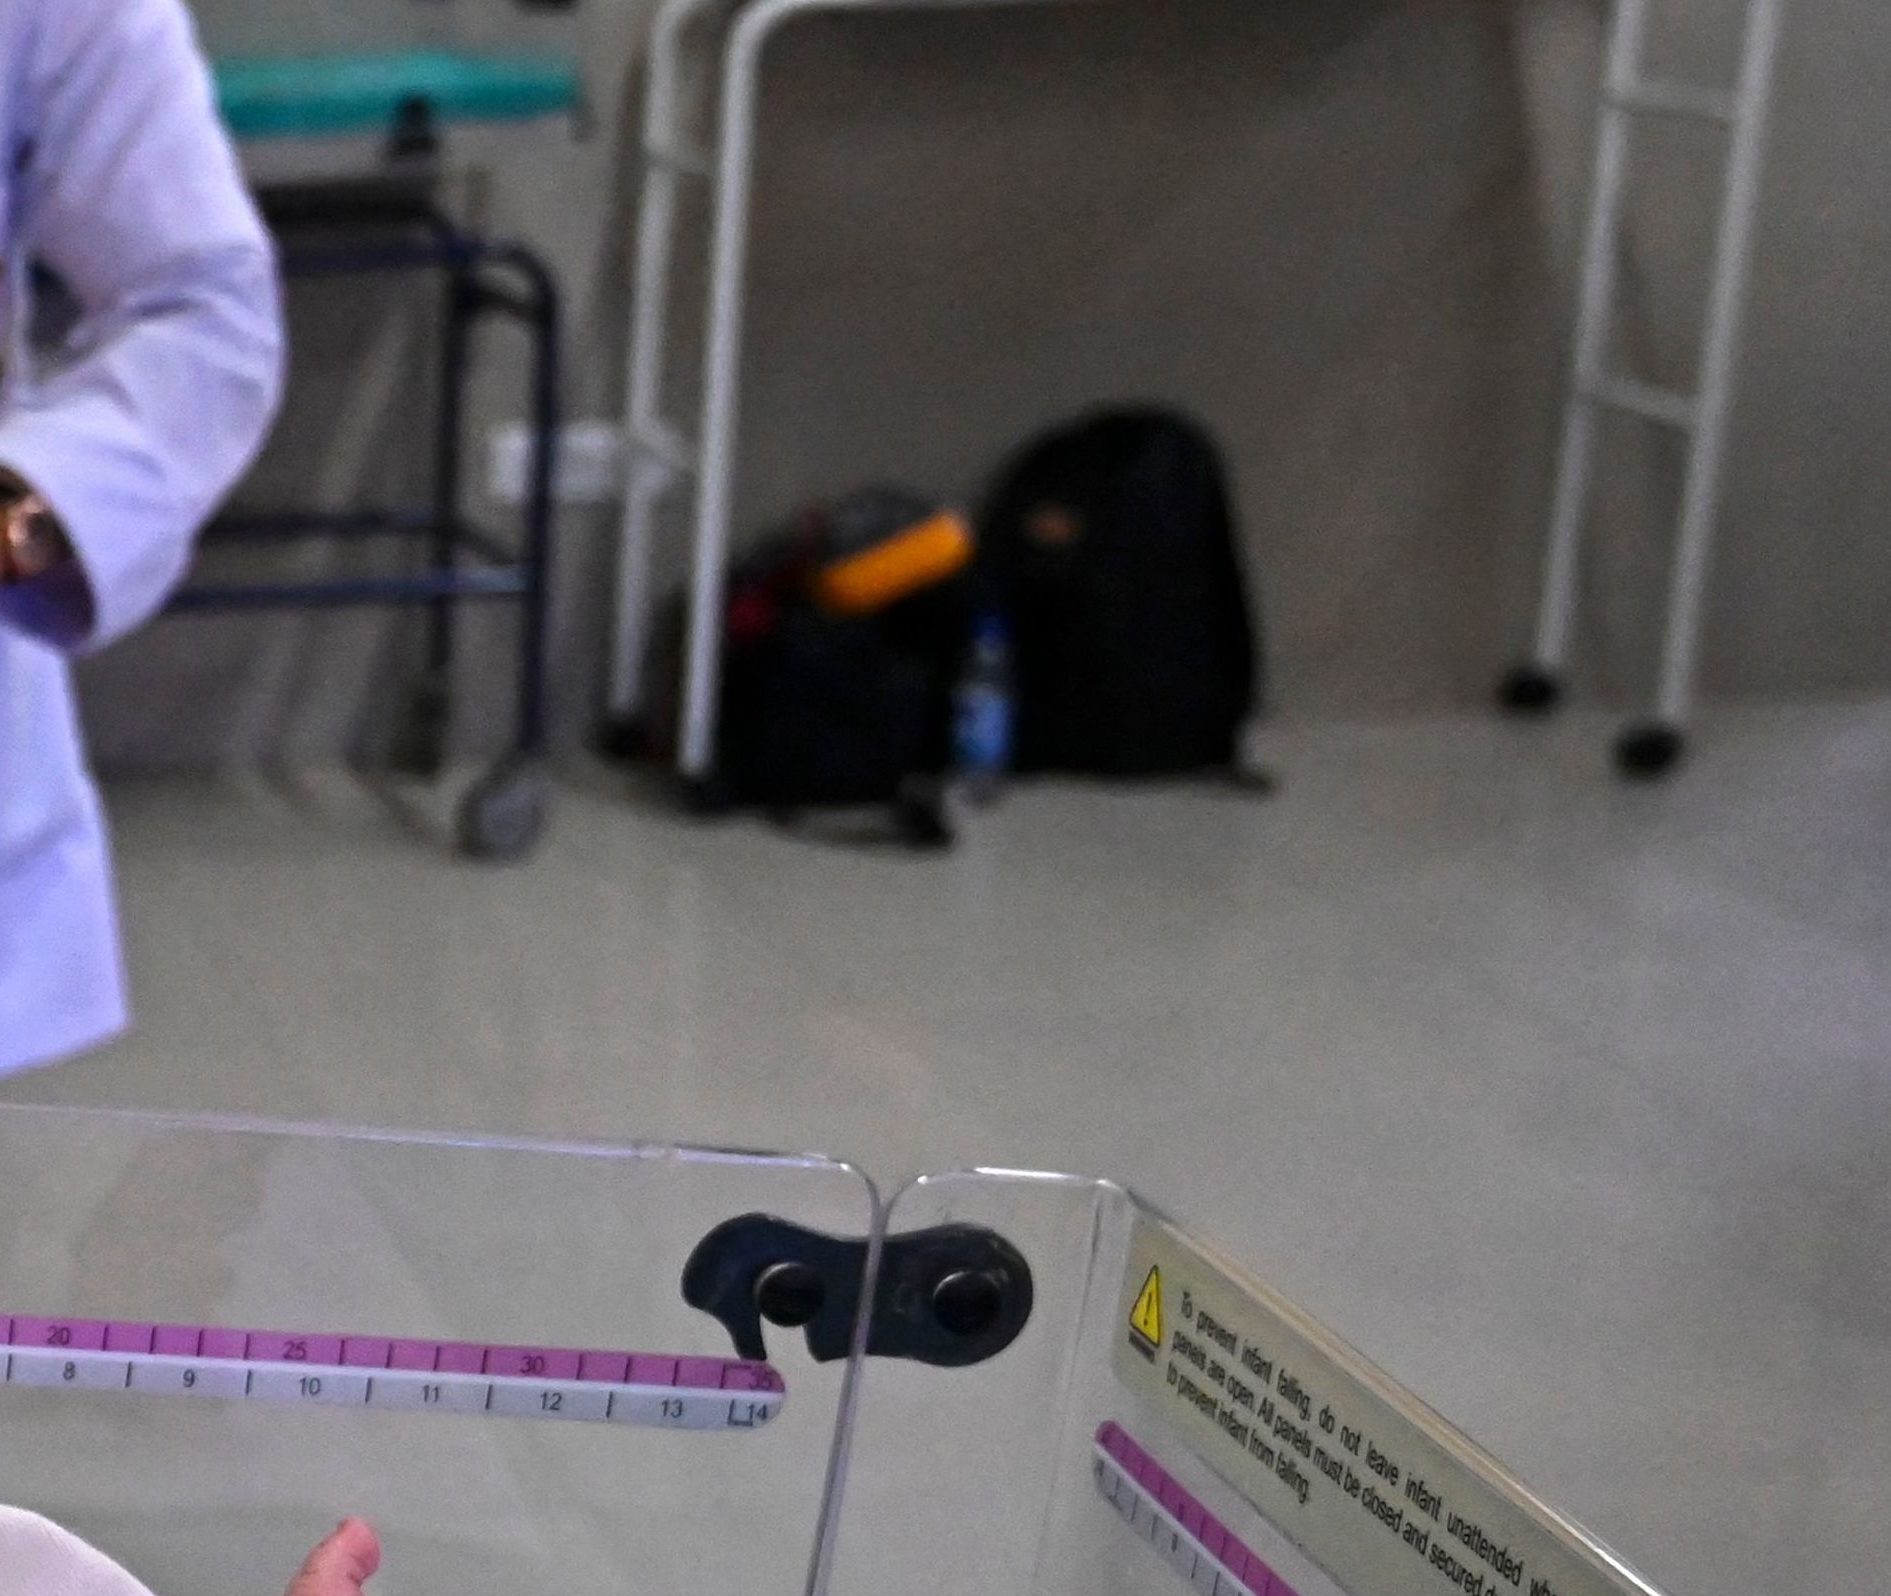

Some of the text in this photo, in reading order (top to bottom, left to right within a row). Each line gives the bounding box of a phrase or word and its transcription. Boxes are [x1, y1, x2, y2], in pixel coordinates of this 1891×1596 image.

[46, 1325, 71, 1346] 20
[281, 1340, 308, 1361] 25
[520, 1355, 546, 1375] 30
[62, 1360, 77, 1382] 8
[182, 1368, 197, 1389] 9
[298, 1376, 323, 1396] 10
[422, 1384, 441, 1403] 11
[540, 1390, 564, 1412] 12
[661, 1399, 684, 1419] 13
[747, 1403, 769, 1421] 14
[1165, 1360, 1179, 1387] to
[1177, 1373, 1218, 1421] prevent
[1217, 1401, 1249, 1448] infant
[1248, 1427, 1275, 1470] from
[1180, 1291, 1193, 1319] To
[1195, 1310, 1238, 1356] prevent
[1240, 1338, 1274, 1386] infant
[1318, 1404, 1336, 1435] do
[1340, 1425, 1362, 1457] not
[1365, 1439, 1400, 1487] leave
[1403, 1471, 1443, 1523] infant
[1446, 1510, 1526, 1587] unattended
[1207, 1358, 1227, 1387] are
[1256, 1395, 1276, 1428] All
[1272, 1413, 1313, 1460] panels
[1312, 1445, 1345, 1487] must
[1342, 1463, 1362, 1500] be
[1361, 1484, 1404, 1535] closed
[1401, 1518, 1432, 1557] and
